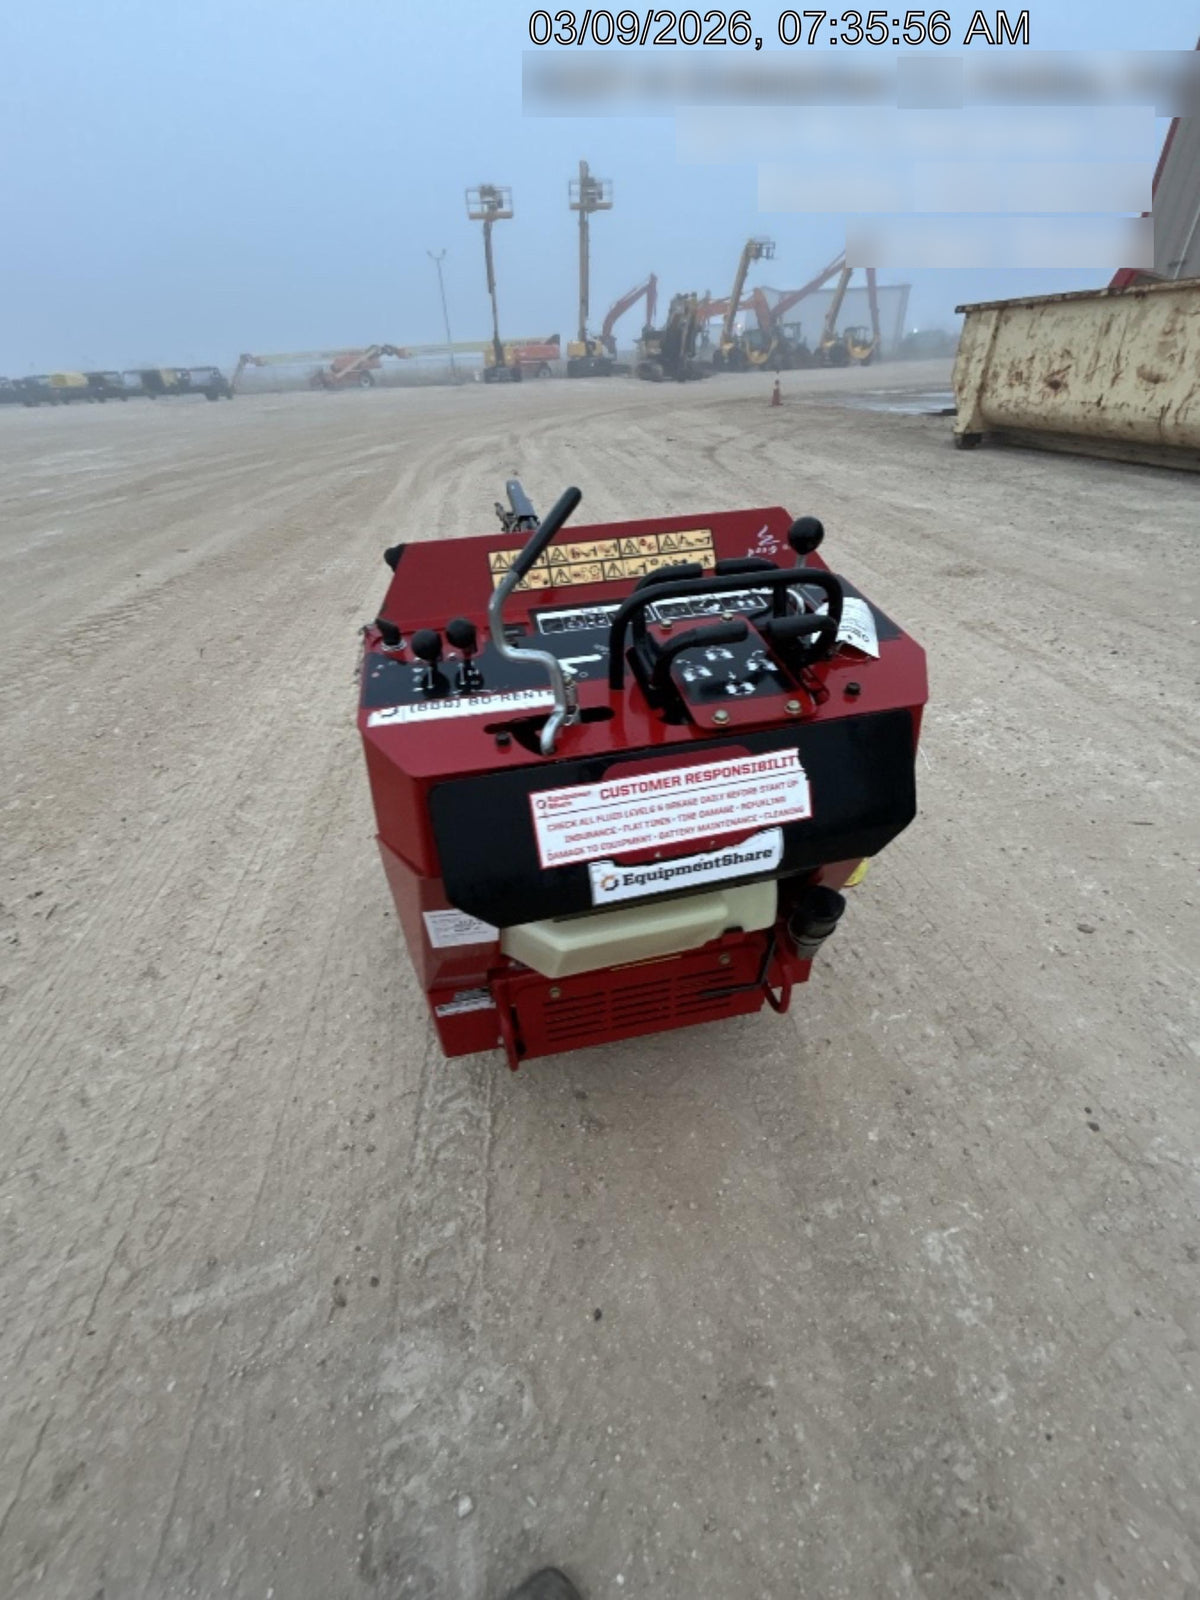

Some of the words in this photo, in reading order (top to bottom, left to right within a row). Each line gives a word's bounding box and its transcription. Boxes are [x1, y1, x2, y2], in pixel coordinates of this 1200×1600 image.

[600, 776, 682, 800] CUSTOMER
[685, 755, 799, 785] RESPONSIBILIT
[622, 848, 773, 887] EquipmentShare
